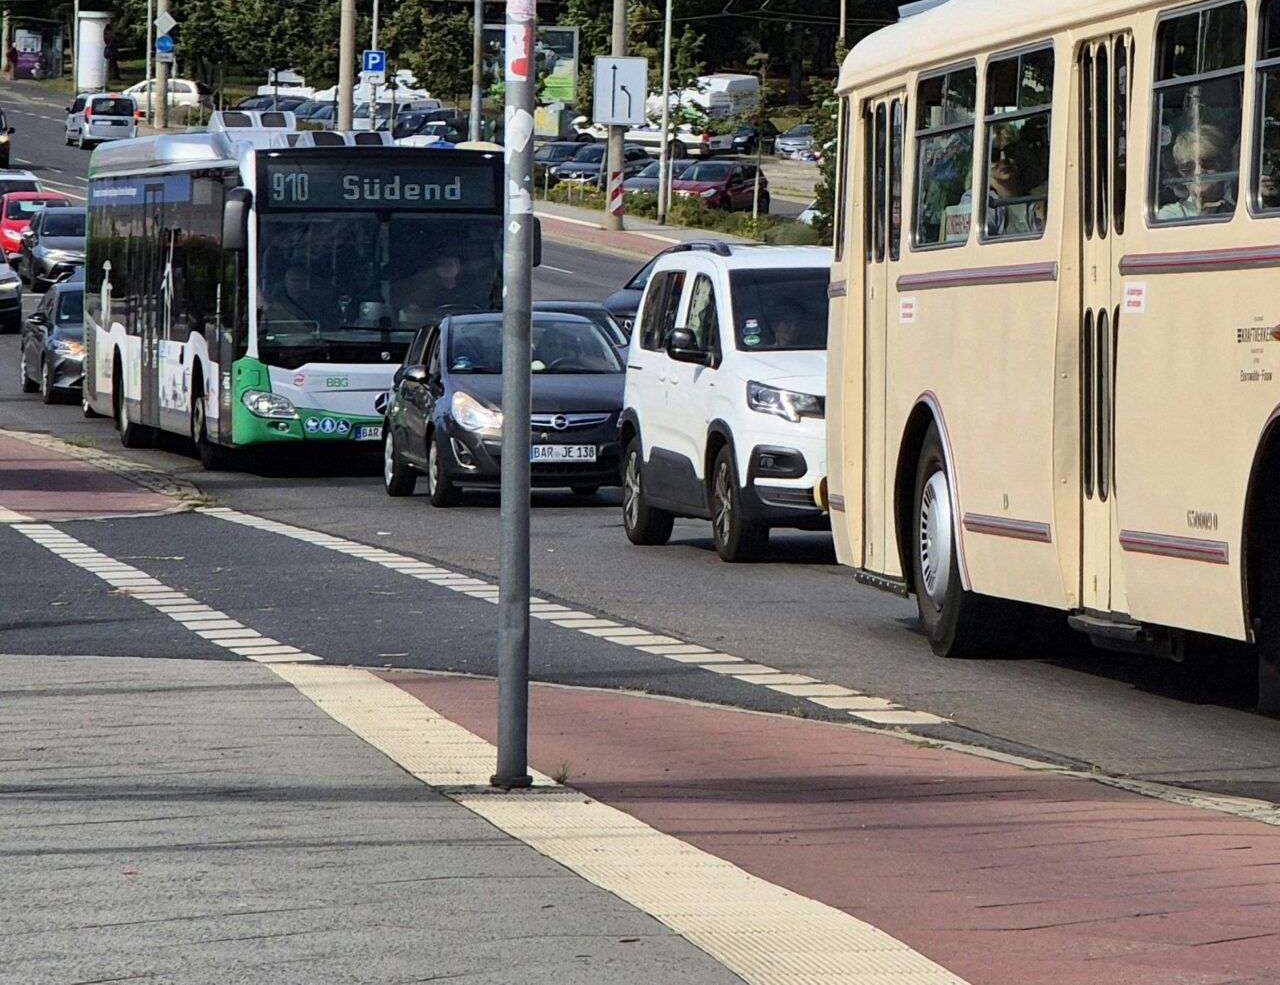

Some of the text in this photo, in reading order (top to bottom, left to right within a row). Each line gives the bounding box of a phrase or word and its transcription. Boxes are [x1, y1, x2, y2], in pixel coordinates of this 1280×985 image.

[368, 53, 381, 69] P
[272, 173, 461, 201] 910 Südend
[326, 378, 349, 387] BBG
[362, 427, 379, 437] BAR
[534, 446, 553, 458] BAR
[562, 446, 574, 458] JE
